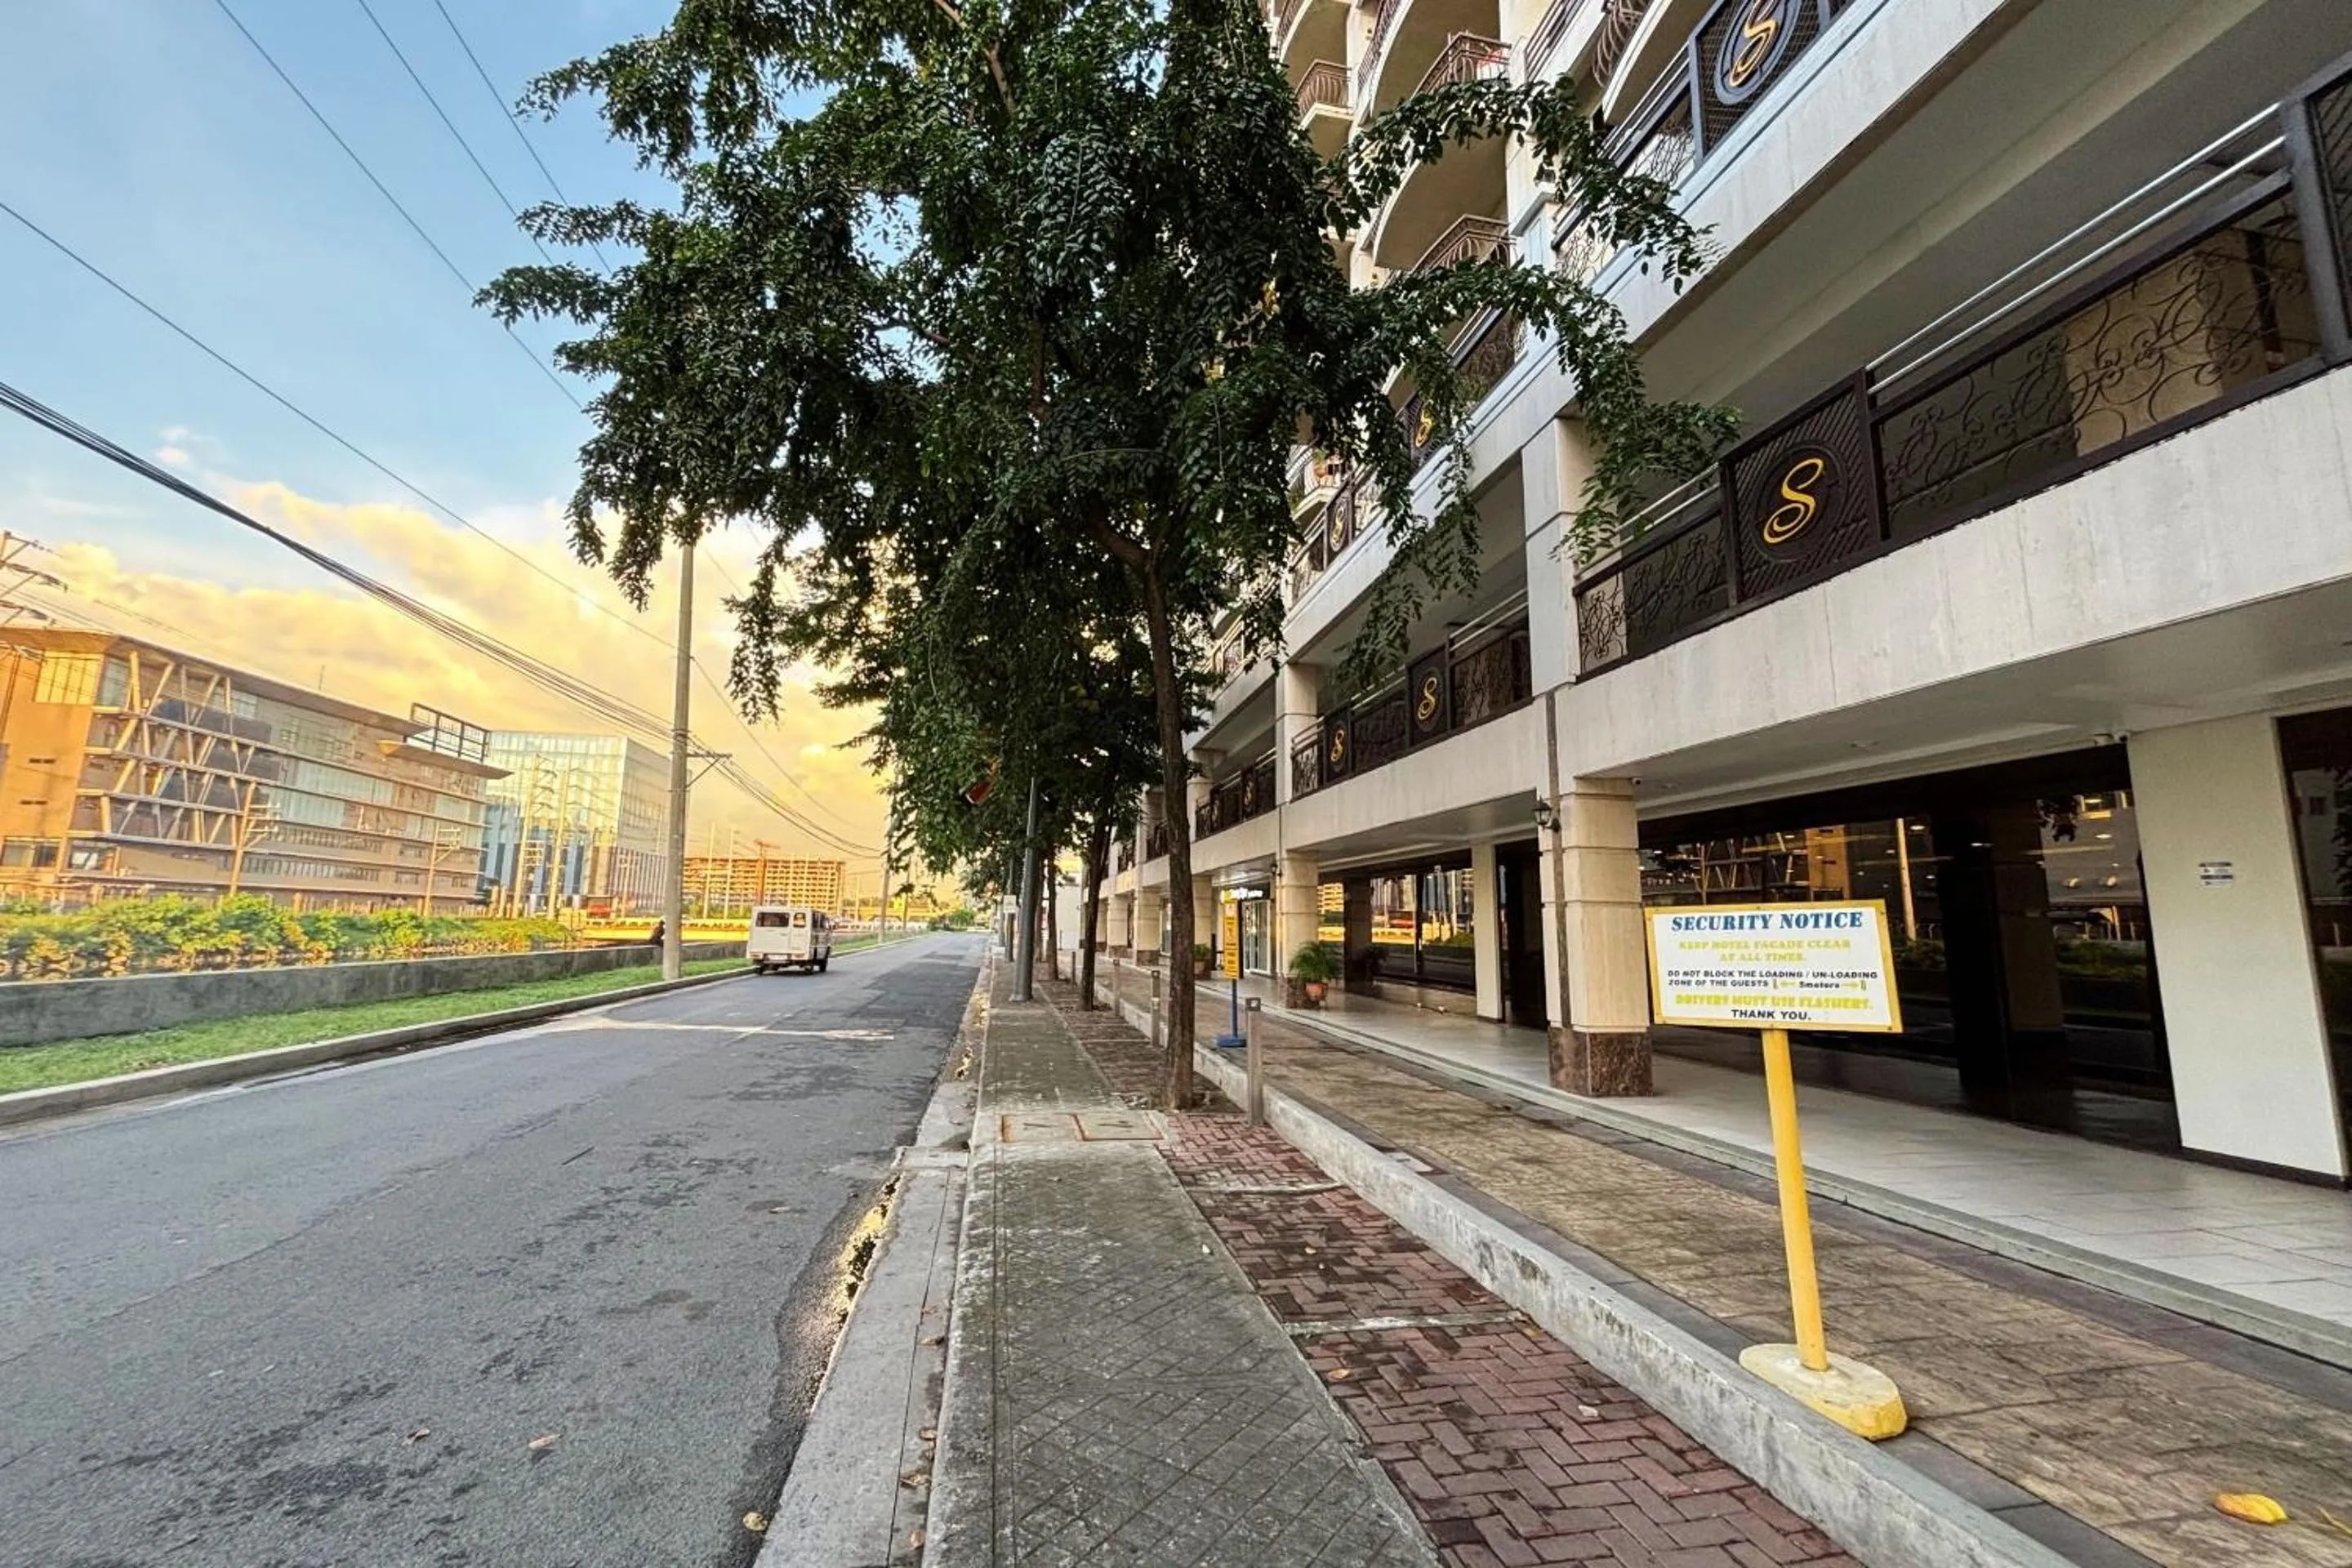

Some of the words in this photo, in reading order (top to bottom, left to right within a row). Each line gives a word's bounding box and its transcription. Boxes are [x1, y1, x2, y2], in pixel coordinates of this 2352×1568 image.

[1763, 457, 1824, 544] S
[1417, 676, 1437, 720] S
[1671, 914, 1772, 931] SECURITY
[1780, 911, 1863, 929] NOTICE
[1753, 940, 1803, 948] FACADE
[1807, 939, 1851, 948] CLEAR
[1719, 953, 1735, 961] AT
[1738, 953, 1762, 961] ALL
[1759, 970, 1803, 978] LOADING
[1812, 971, 1878, 979] UN-LOADING
[1731, 1009, 1775, 1018] THANK
[1780, 1011, 1812, 1021] YOU.
